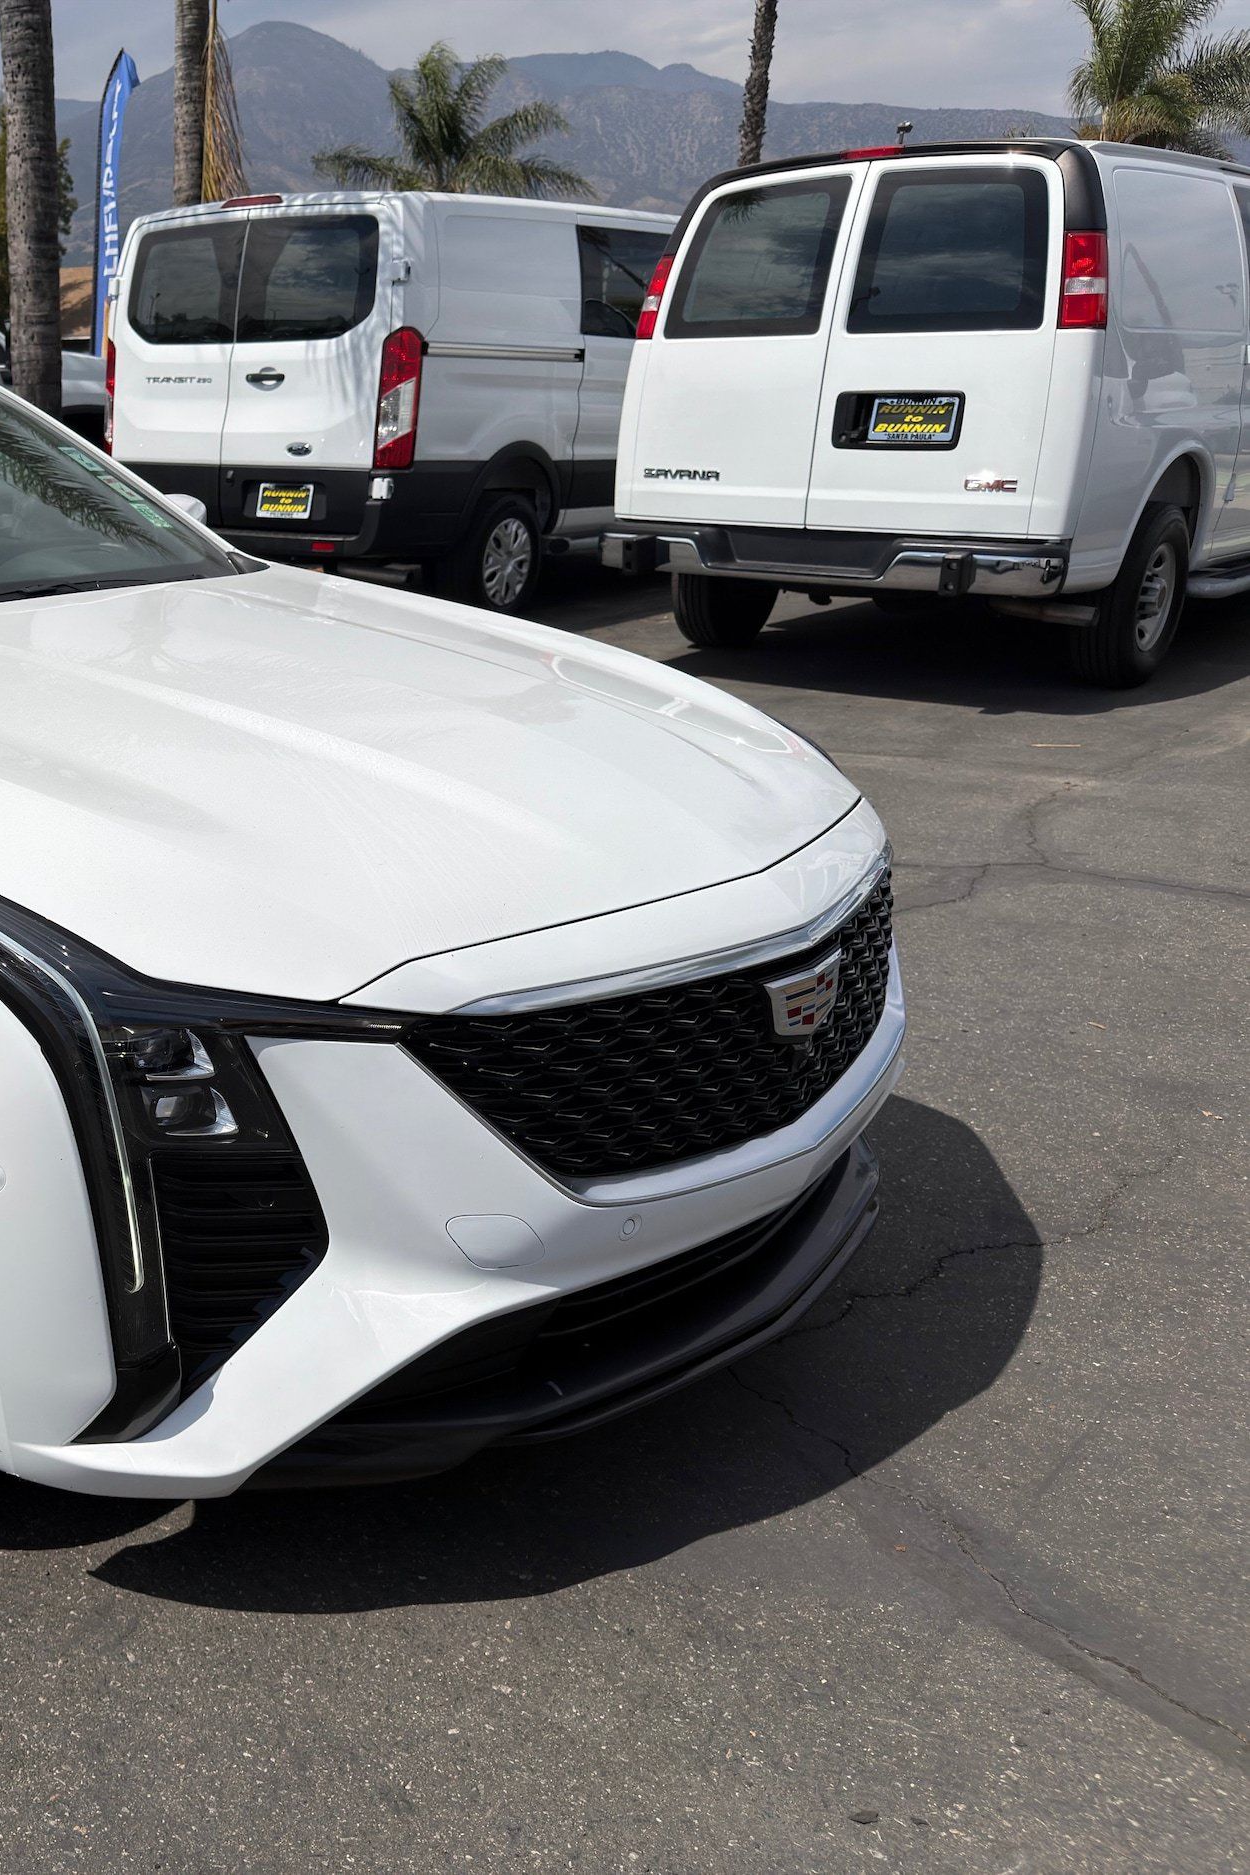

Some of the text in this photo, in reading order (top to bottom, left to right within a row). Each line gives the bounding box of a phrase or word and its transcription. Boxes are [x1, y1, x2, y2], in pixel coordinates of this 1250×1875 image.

[145, 376, 196, 384] TRANSIT
[904, 414, 924, 423] to
[874, 423, 947, 433] BUNNIN
[643, 468, 720, 481] SAVANA
[963, 478, 1018, 492] GMC
[261, 503, 306, 512] BUNNIN
